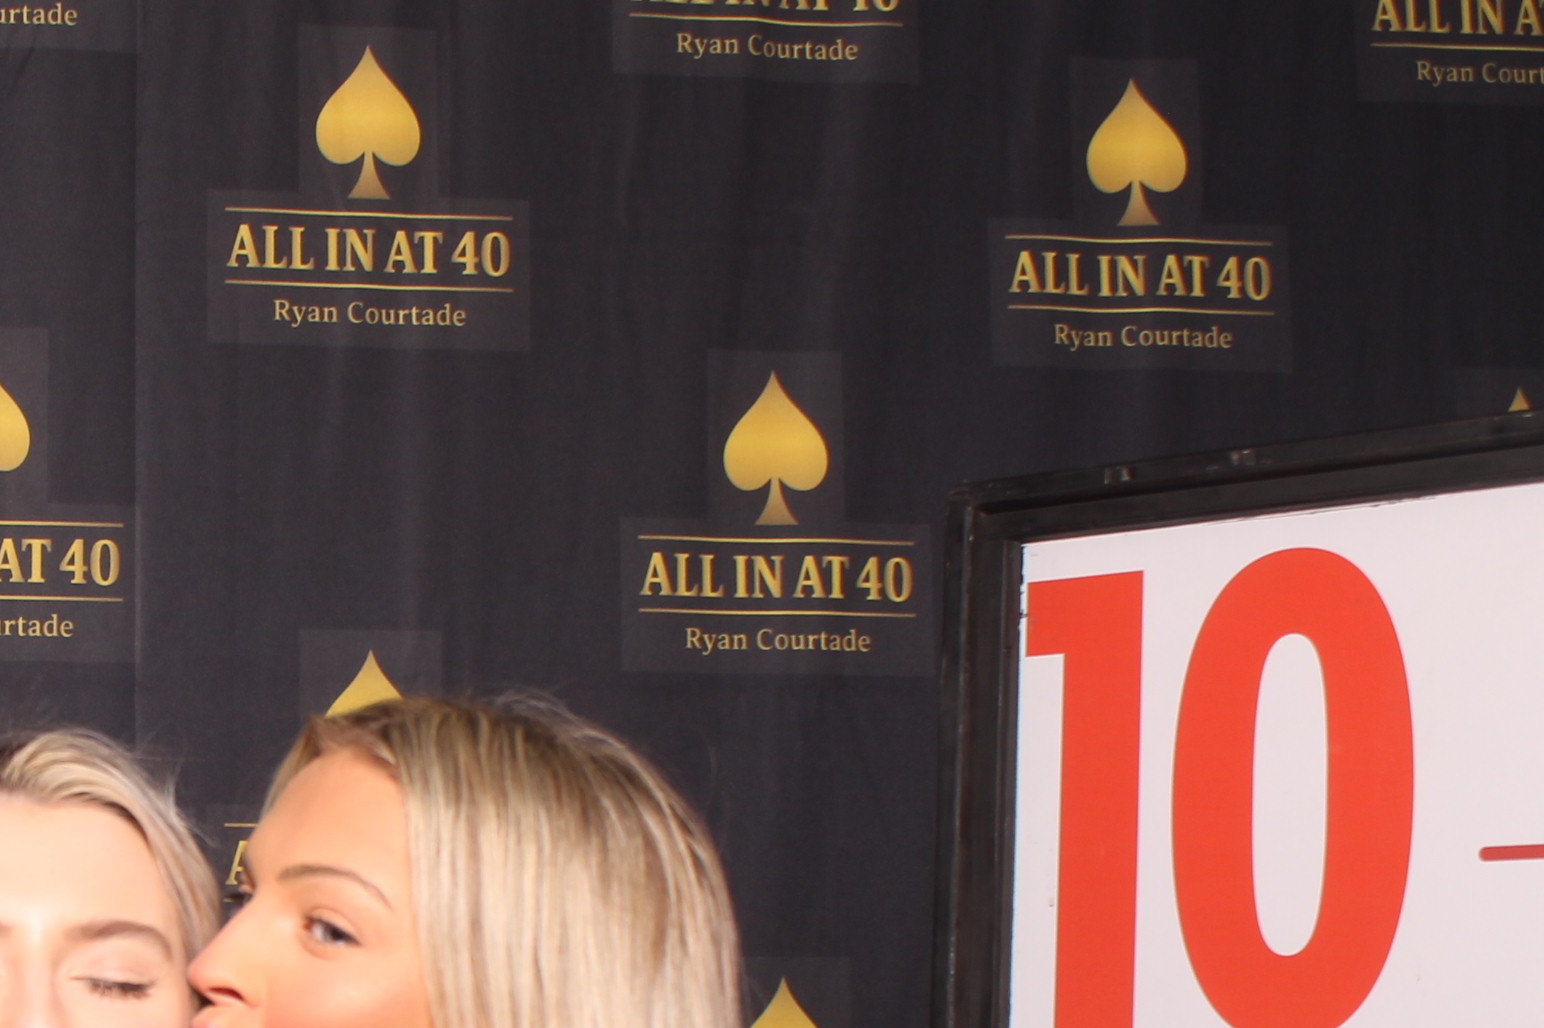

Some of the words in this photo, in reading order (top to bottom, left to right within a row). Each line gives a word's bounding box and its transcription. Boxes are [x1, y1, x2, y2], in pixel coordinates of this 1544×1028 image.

[1371, 0, 1451, 33] ALL
[1460, 0, 1504, 35] IN
[1514, 0, 1544, 36] A
[676, 32, 740, 59] Ryan
[748, 33, 860, 60] Courtade
[1416, 59, 1474, 87] Ryan
[227, 223, 314, 271] ALL
[325, 226, 376, 272] IN
[385, 228, 443, 274] AT
[451, 230, 511, 277] 40
[1008, 250, 1089, 295] ALL
[1097, 254, 1147, 297] IN
[1156, 254, 1209, 298] AT
[1216, 256, 1272, 301] 40
[273, 298, 338, 327] Ryan
[347, 300, 466, 327] Courtade
[1054, 323, 1112, 351] Ryan
[1121, 325, 1233, 349] Courtade
[60, 538, 121, 586] 40
[641, 552, 724, 599] ALL
[733, 554, 784, 599] IN
[794, 555, 849, 600] AT
[857, 556, 913, 603] 40
[685, 627, 748, 656] Ryan
[757, 628, 871, 653] Courtade
